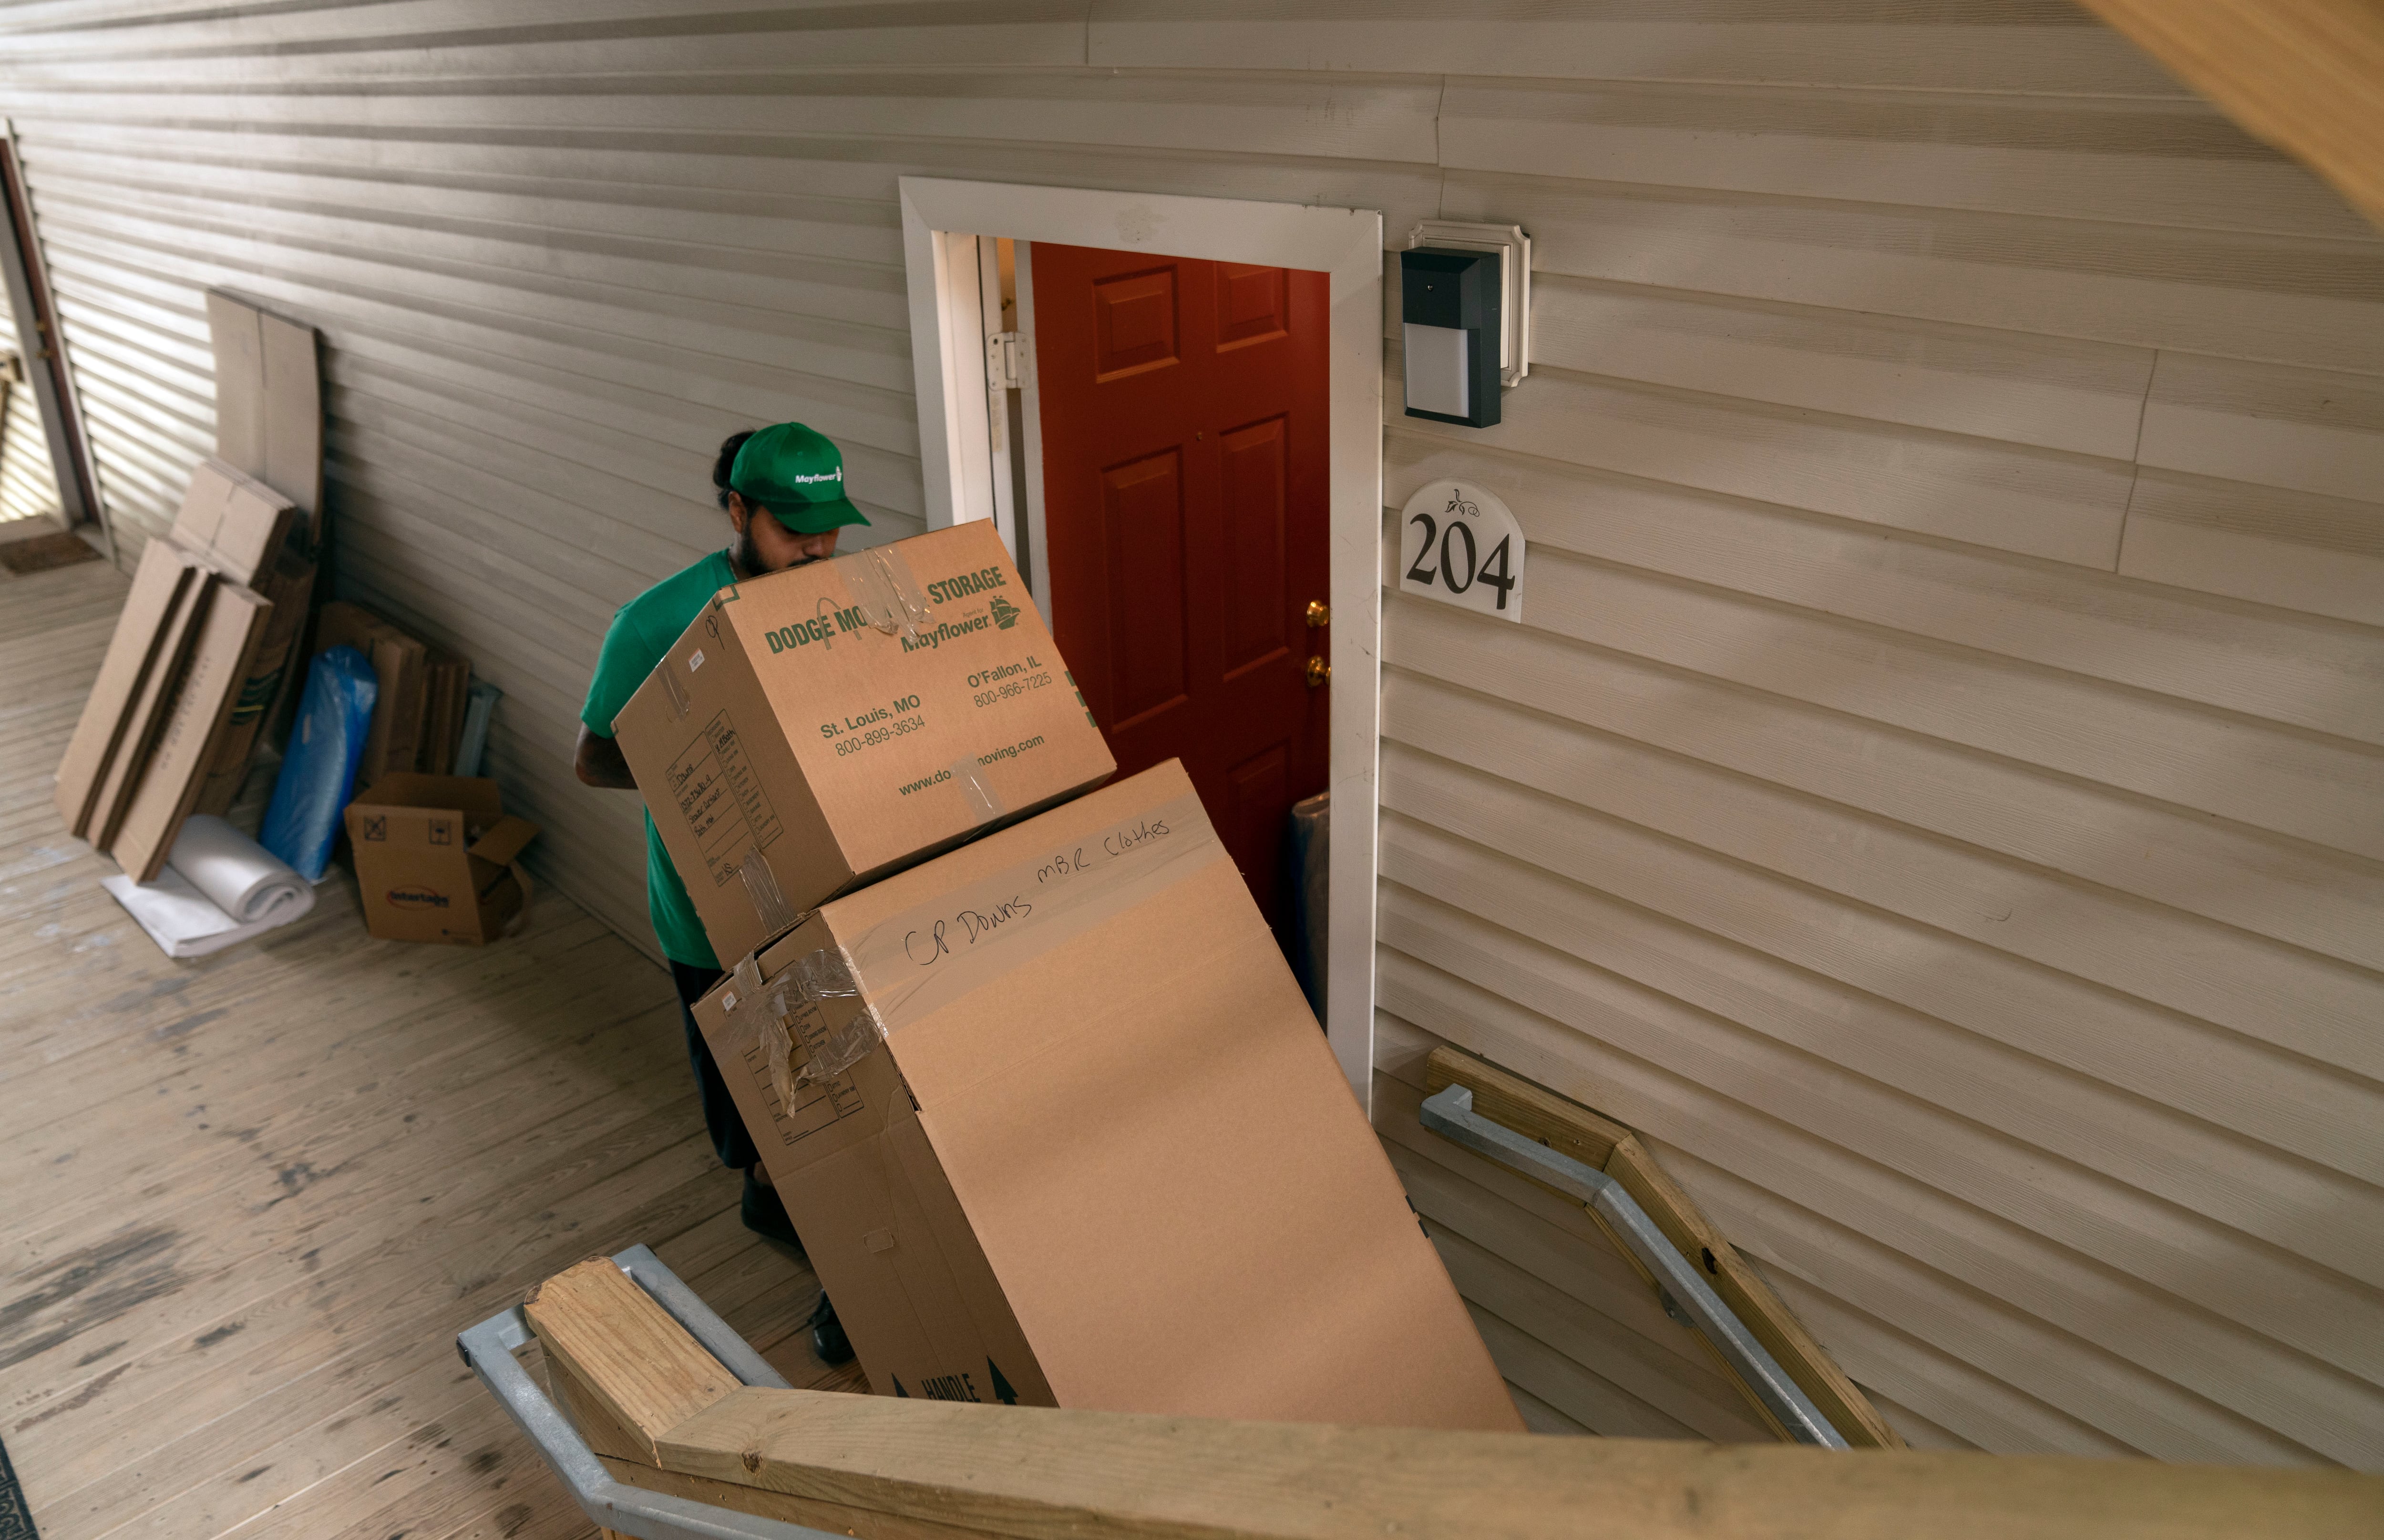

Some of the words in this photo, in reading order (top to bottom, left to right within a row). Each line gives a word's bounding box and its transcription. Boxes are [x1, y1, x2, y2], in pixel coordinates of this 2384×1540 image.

[795, 473, 836, 484] Mayflower
[1407, 513, 1515, 610] 204
[927, 566, 1007, 605] STORAGE
[764, 610, 836, 654] DODGE
[900, 614, 990, 653] Mayflower
[967, 663, 1027, 688] O'Fallon,
[1027, 656, 1042, 669] IL
[974, 671, 1052, 708] 800-966-7225
[821, 722, 844, 739] St.
[845, 706, 894, 731] Louis,
[894, 694, 921, 714] MO
[835, 715, 925, 757] 800-899-3634
[1104, 820, 1169, 856] Clothes
[921, 1373, 981, 1403] HANDLE
